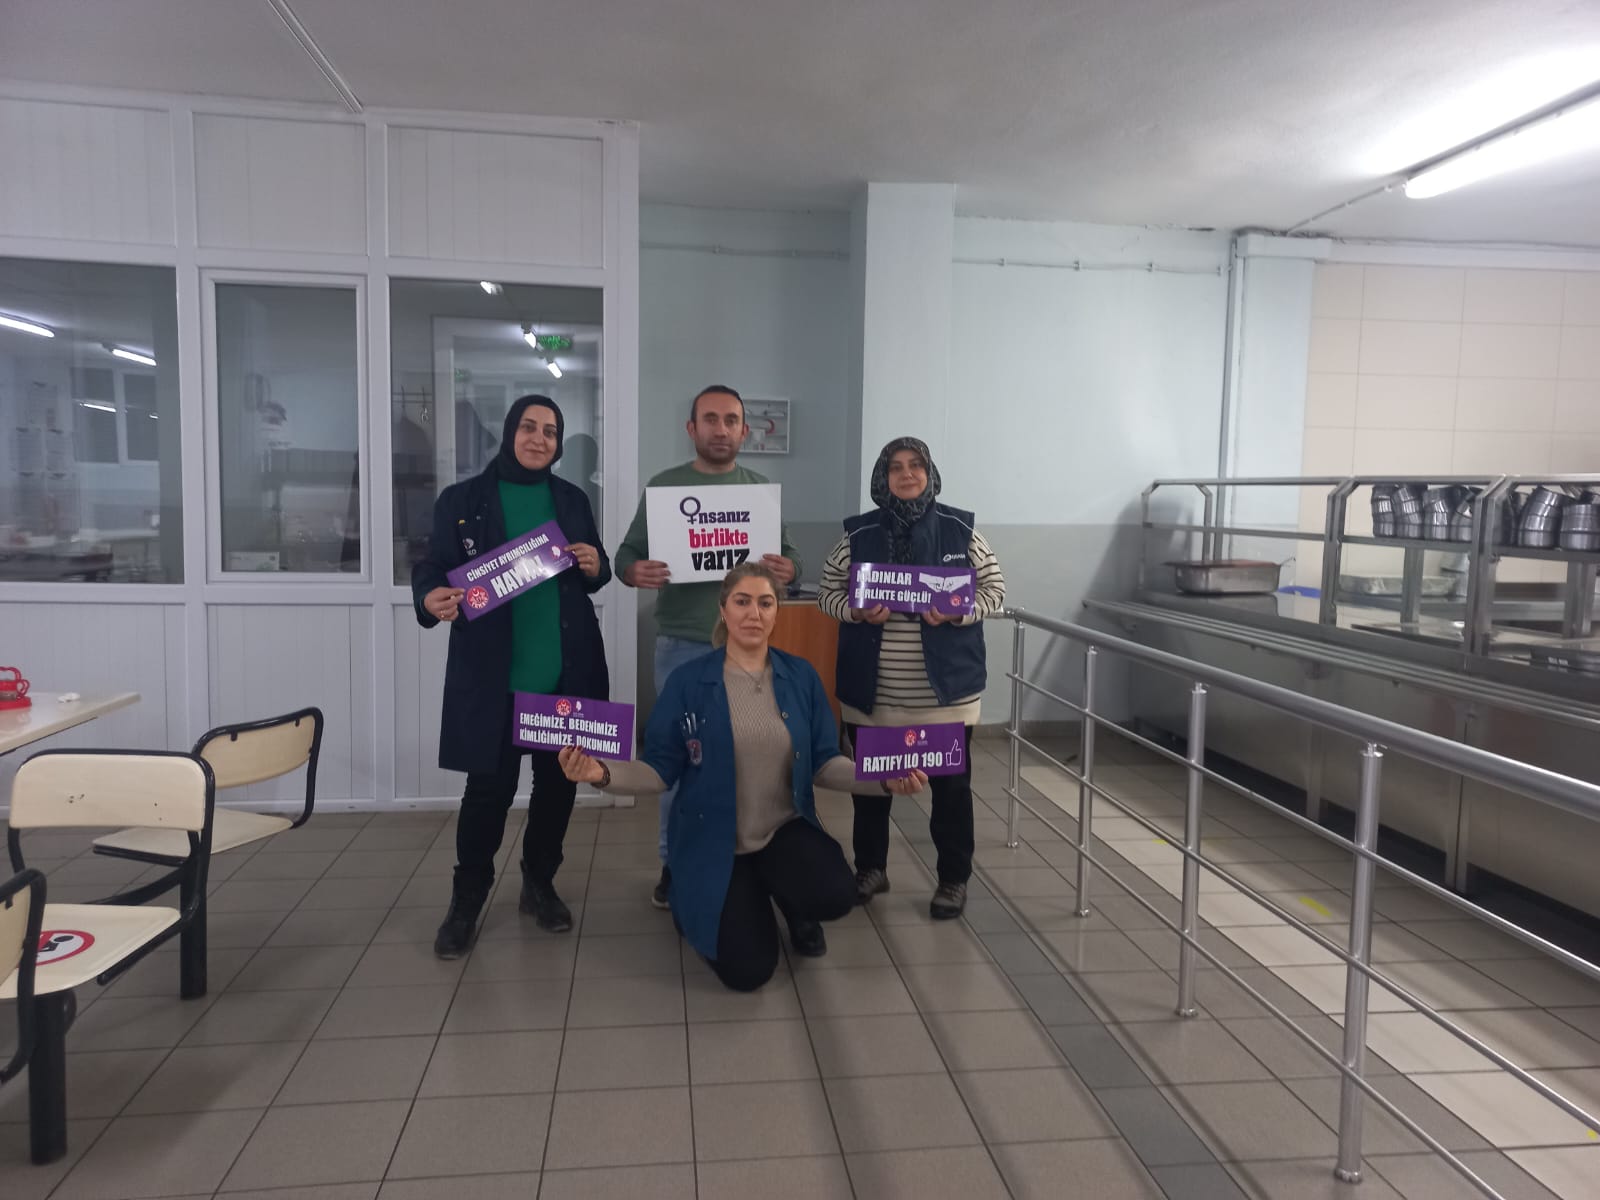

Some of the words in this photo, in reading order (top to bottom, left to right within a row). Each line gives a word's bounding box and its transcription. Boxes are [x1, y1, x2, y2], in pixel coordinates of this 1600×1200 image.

[689, 528, 748, 548] birlikte
[466, 558, 500, 582] CİNSİYET
[568, 718, 618, 737] BEDENİMİZE
[862, 754, 902, 773] RATIFY
[903, 753, 919, 769] ILO
[921, 751, 943, 768] 190
